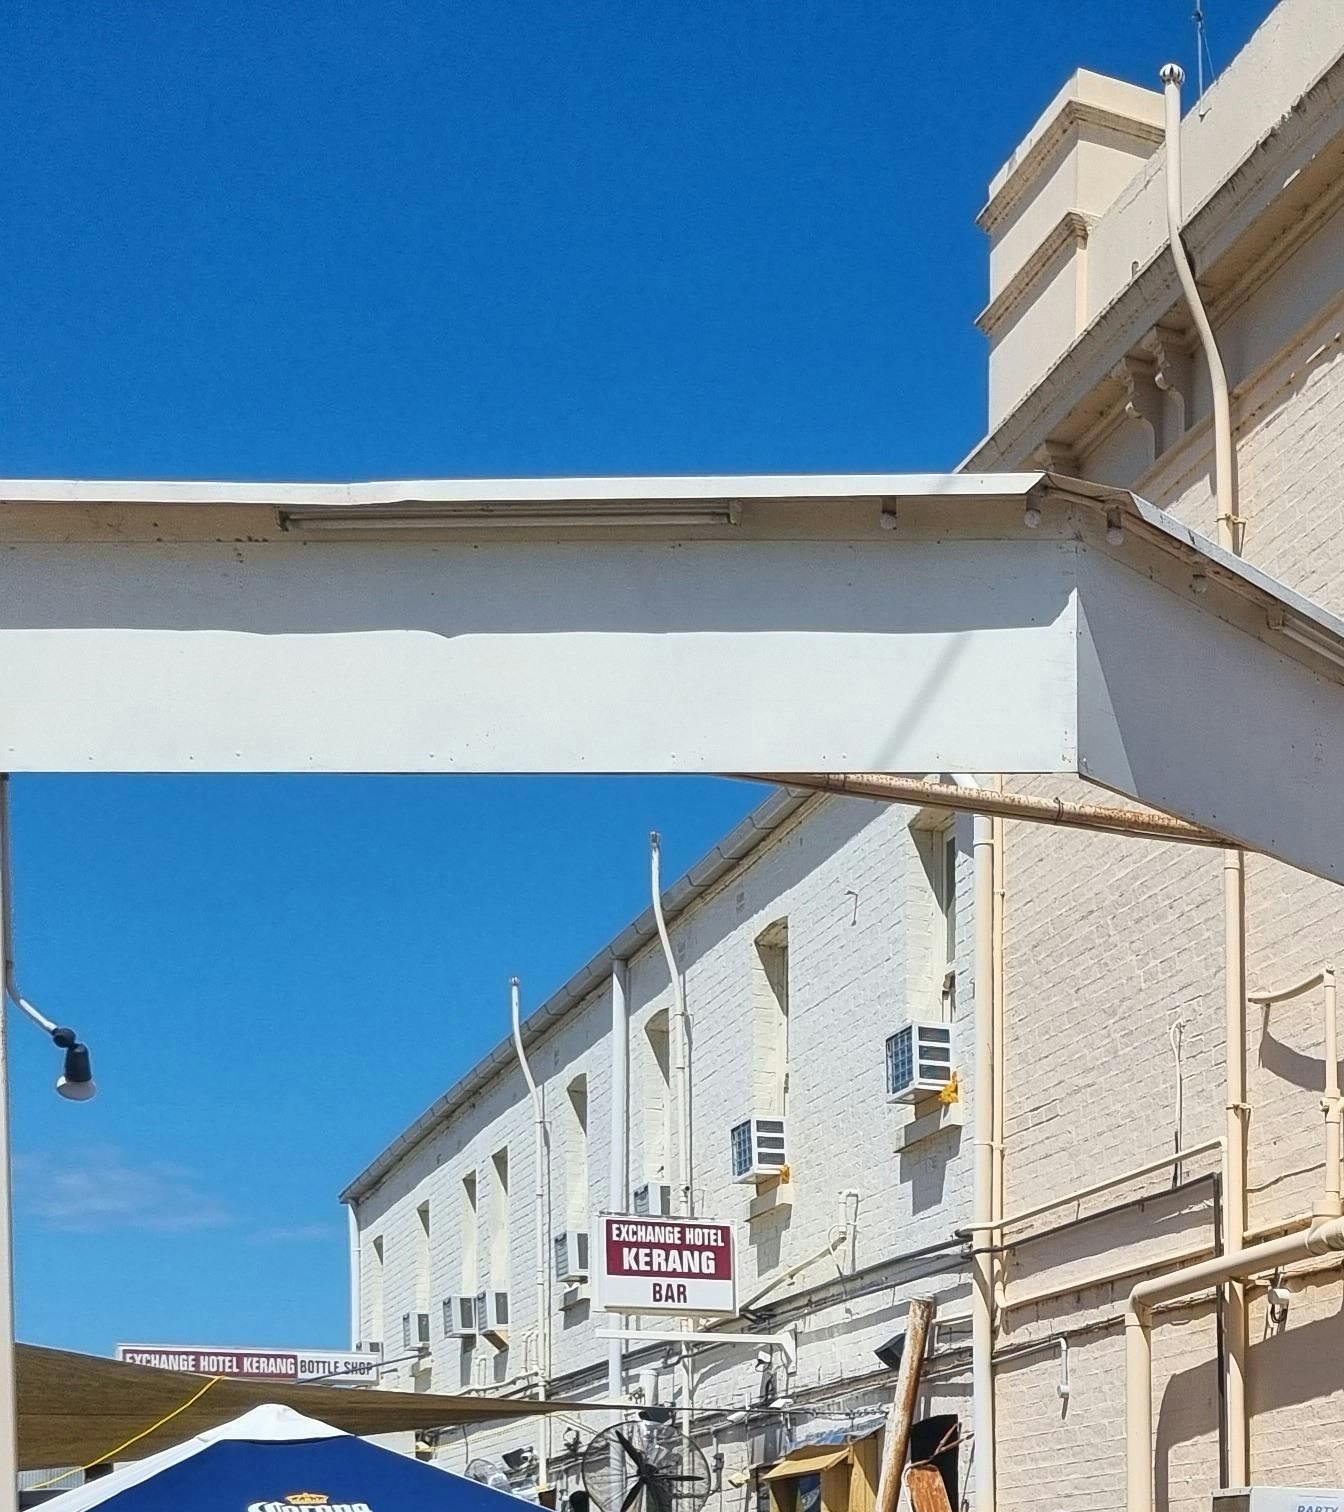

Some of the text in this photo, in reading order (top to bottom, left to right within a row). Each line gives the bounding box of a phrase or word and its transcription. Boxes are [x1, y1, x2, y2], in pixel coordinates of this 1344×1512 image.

[611, 1223, 725, 1247] EXCHANGE HOTEL
[622, 1247, 716, 1274] KERANG
[652, 1282, 688, 1304] BAR
[199, 1355, 240, 1373] HOTEL
[243, 1357, 296, 1375] KERANG
[300, 1359, 340, 1374] BOTTLE
[344, 1360, 374, 1376] SHOP
